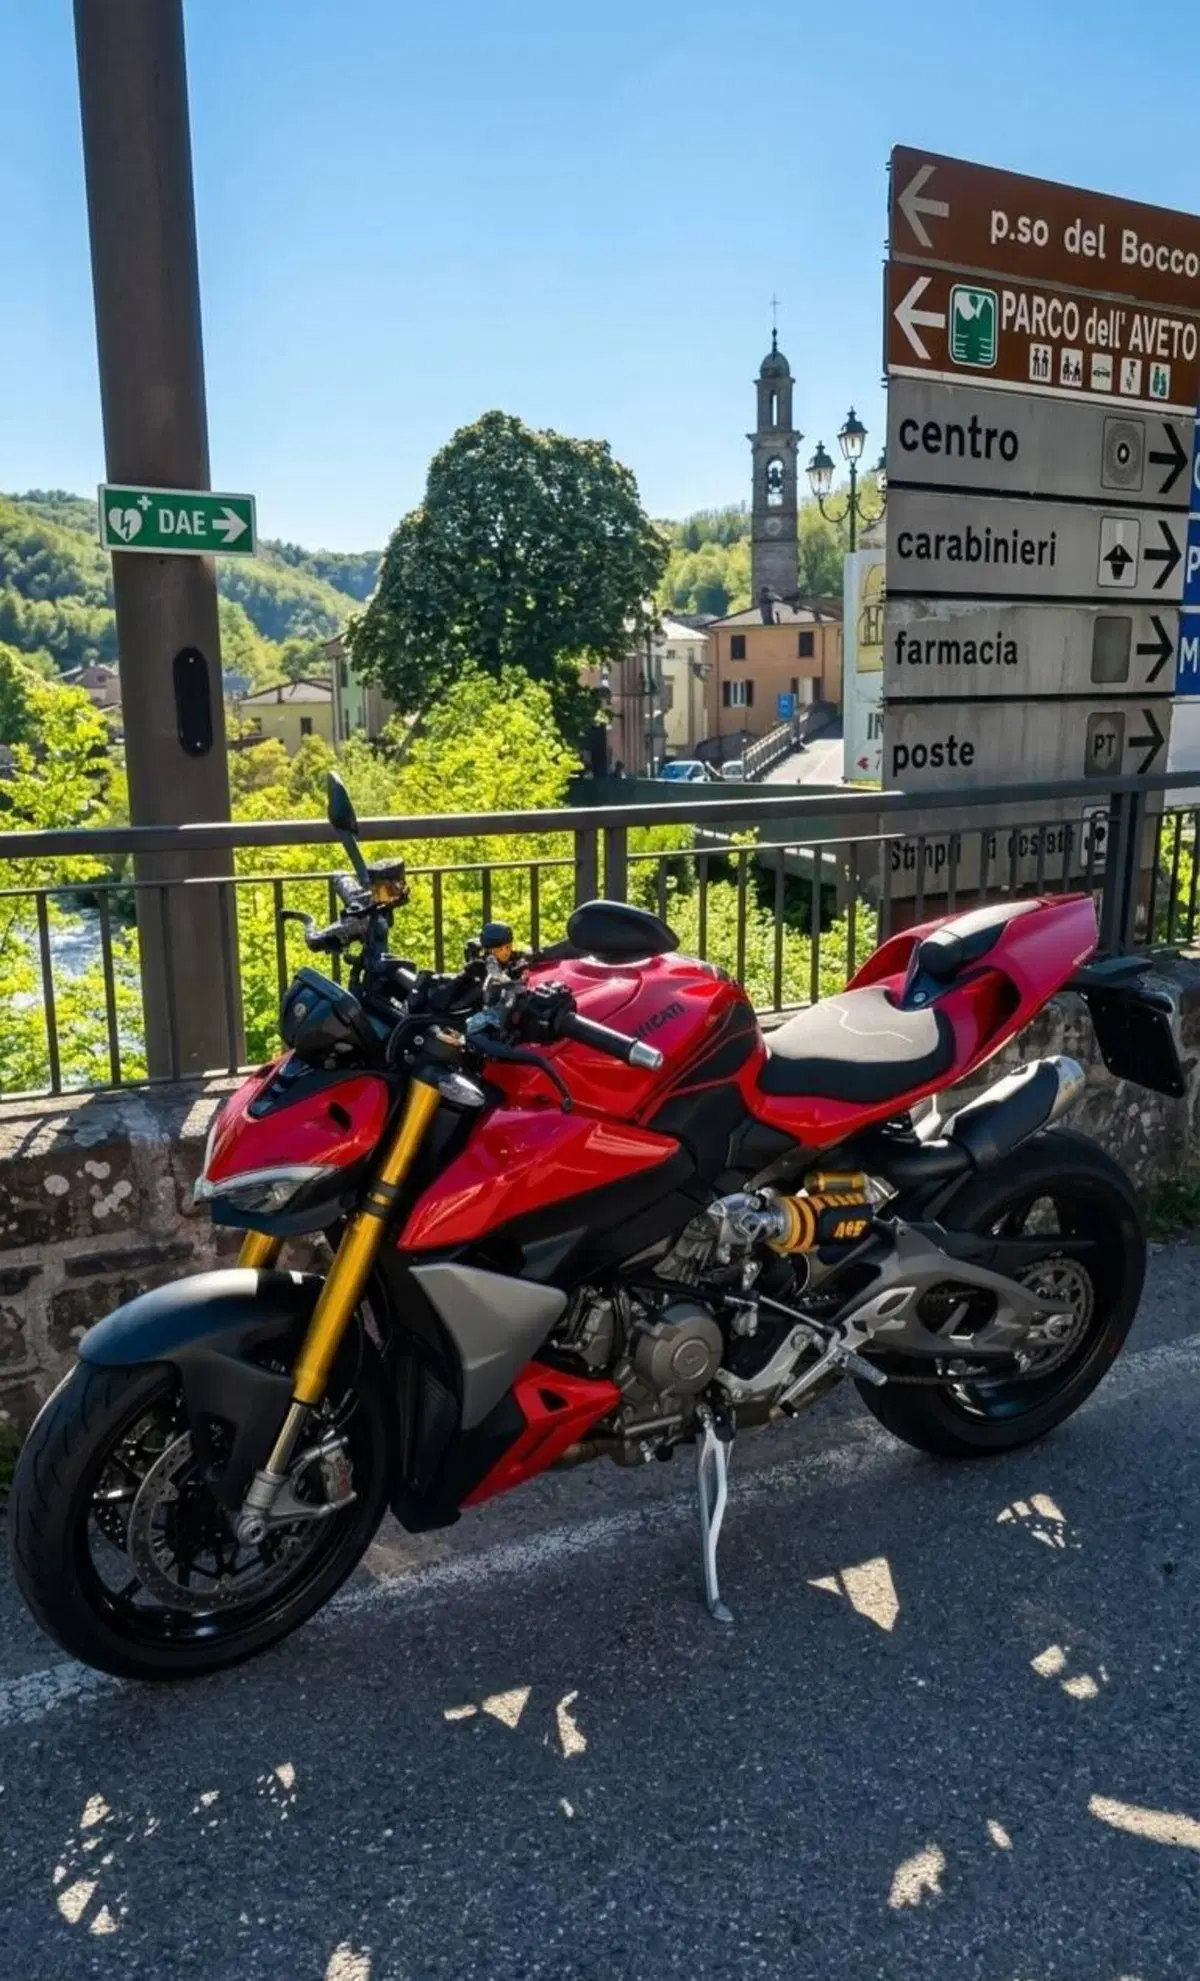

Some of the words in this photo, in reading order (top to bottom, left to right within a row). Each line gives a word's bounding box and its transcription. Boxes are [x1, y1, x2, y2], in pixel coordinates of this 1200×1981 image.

[990, 208, 1050, 247] p.so
[1064, 218, 1106, 259] del
[1121, 229, 1199, 278] Bocco
[1001, 290, 1080, 340] PARCO
[1085, 307, 1126, 348] dell'
[1128, 313, 1197, 361] AVETO
[899, 415, 1019, 462] centro
[158, 508, 207, 536] DAE
[896, 525, 1057, 567] carabinieri
[894, 631, 1018, 666] farmacia
[892, 735, 975, 777] poste
[1093, 733, 1116, 757] PT
[633, 1001, 686, 1041] UCATI
